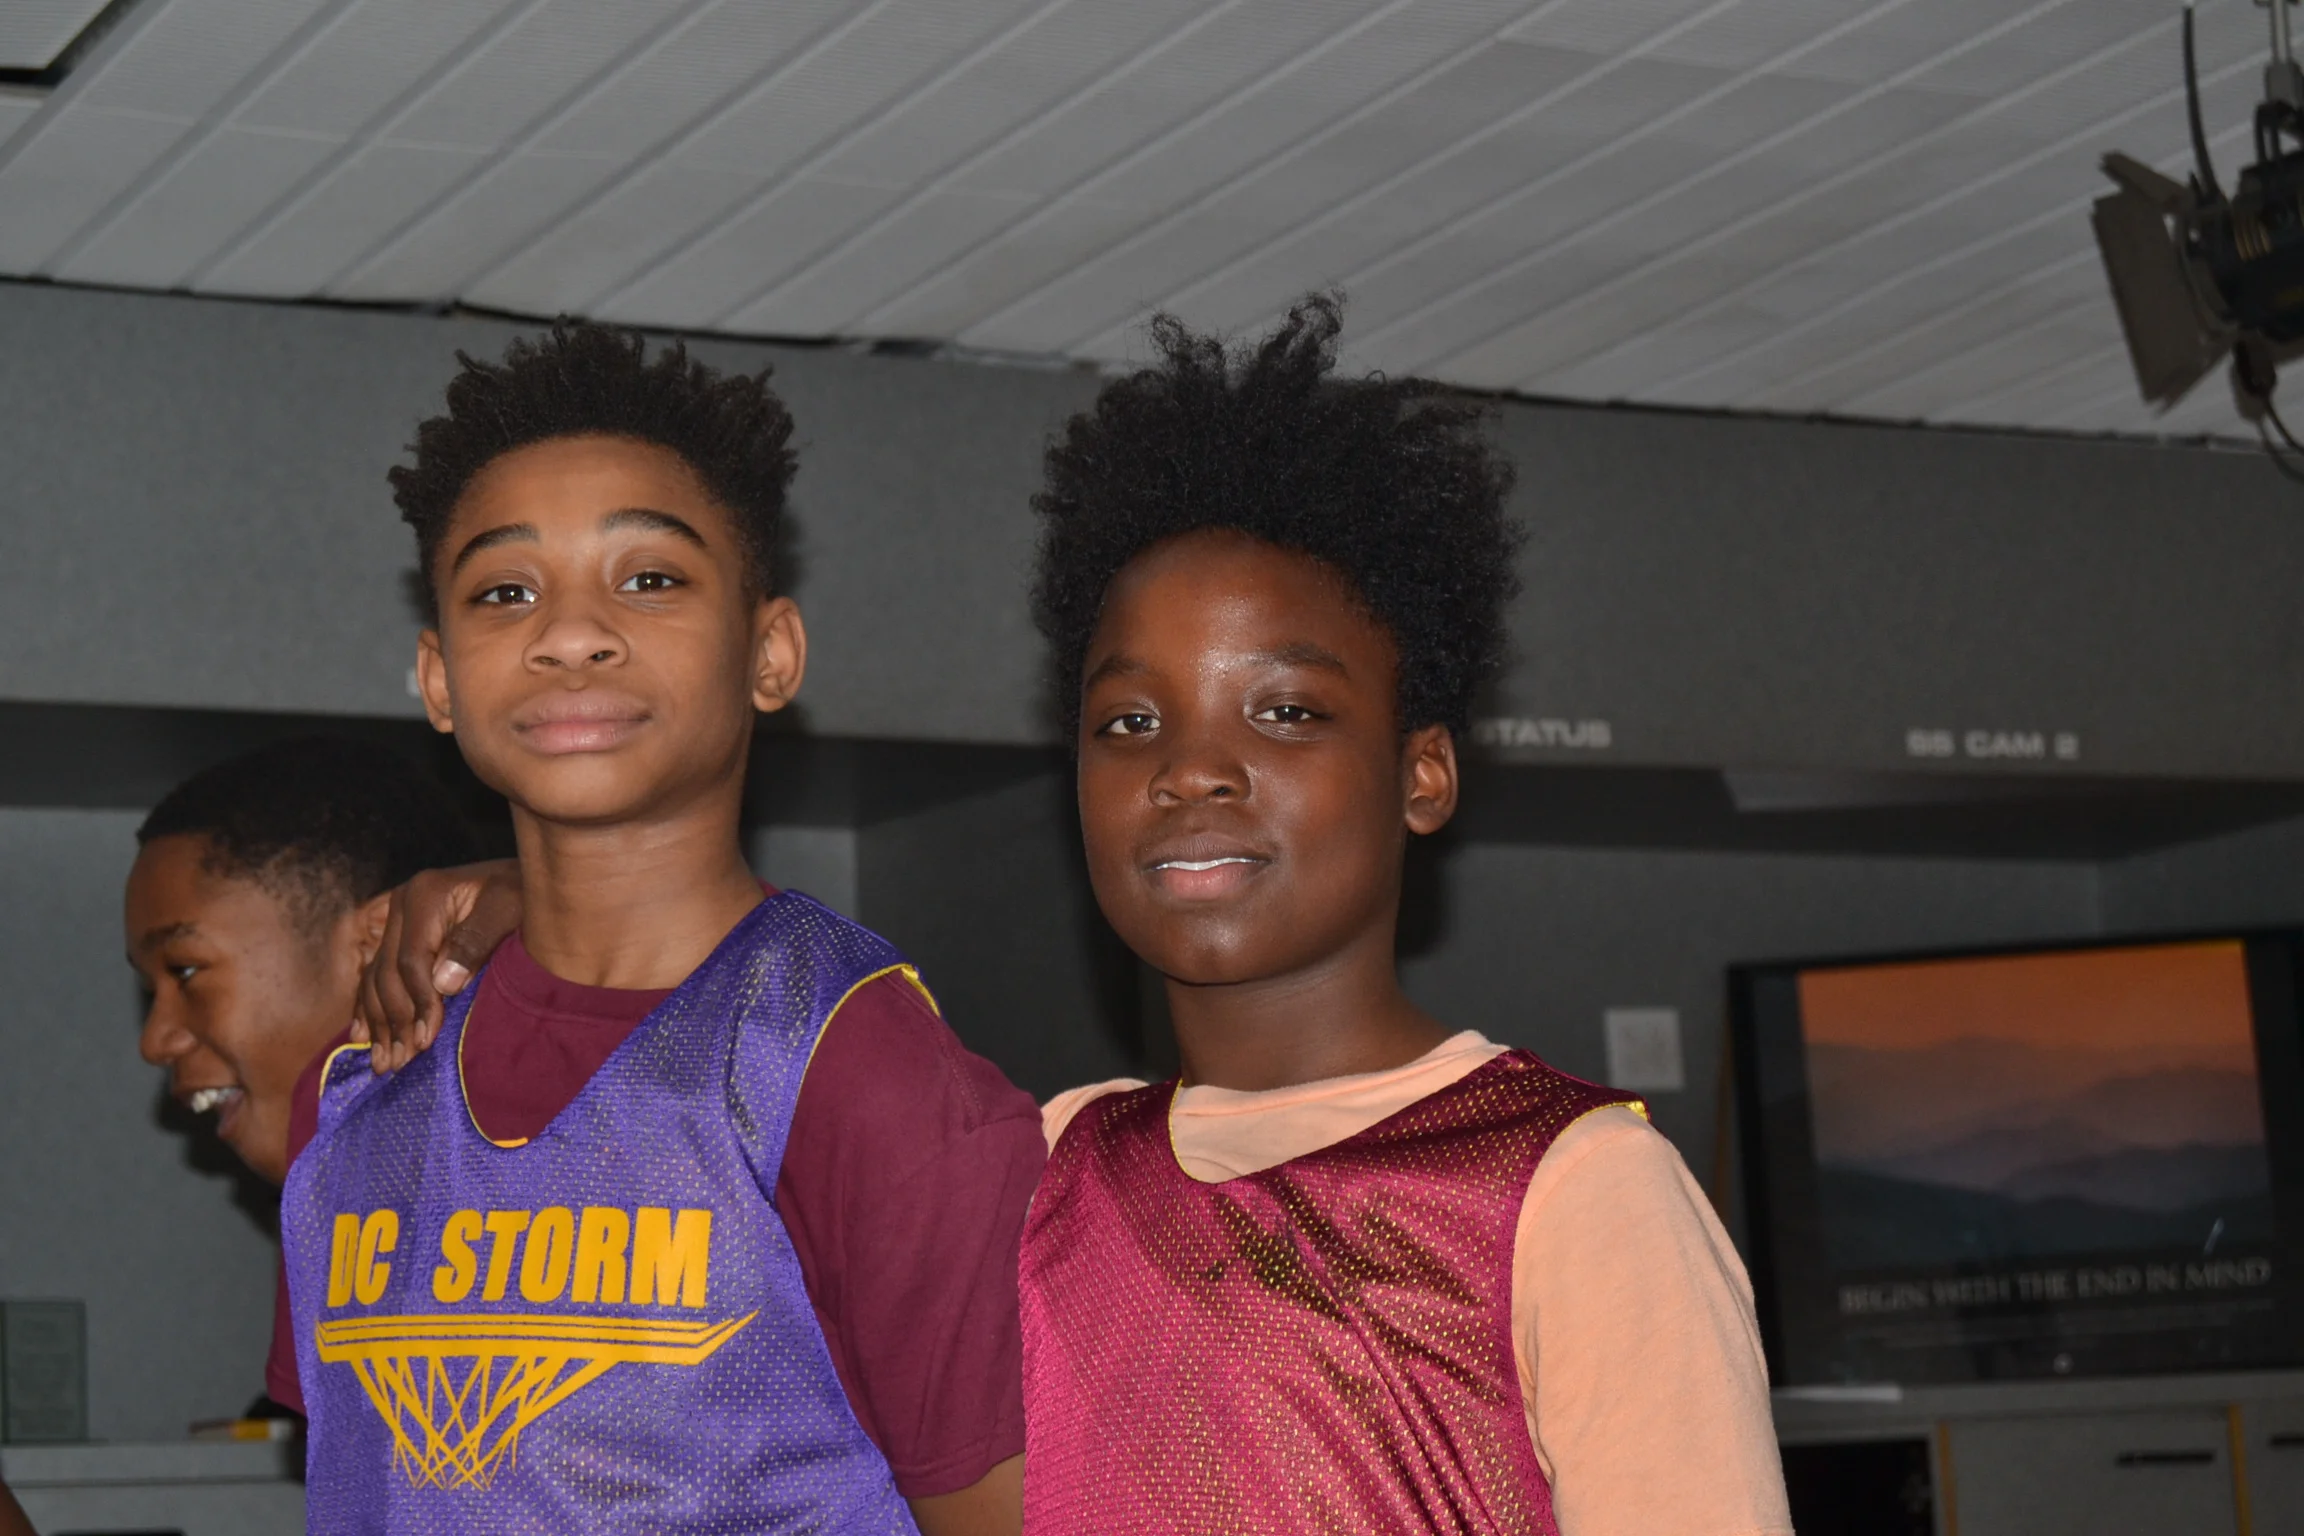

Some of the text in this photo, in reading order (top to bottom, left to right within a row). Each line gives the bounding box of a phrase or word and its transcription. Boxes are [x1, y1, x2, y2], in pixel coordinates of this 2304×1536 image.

[1965, 730, 2046, 760] CAM
[2055, 732, 2080, 761] 2
[327, 1206, 713, 1309] DC STORM
[1839, 1256, 2270, 1315] BEGIN WITH THE END IN MIND
